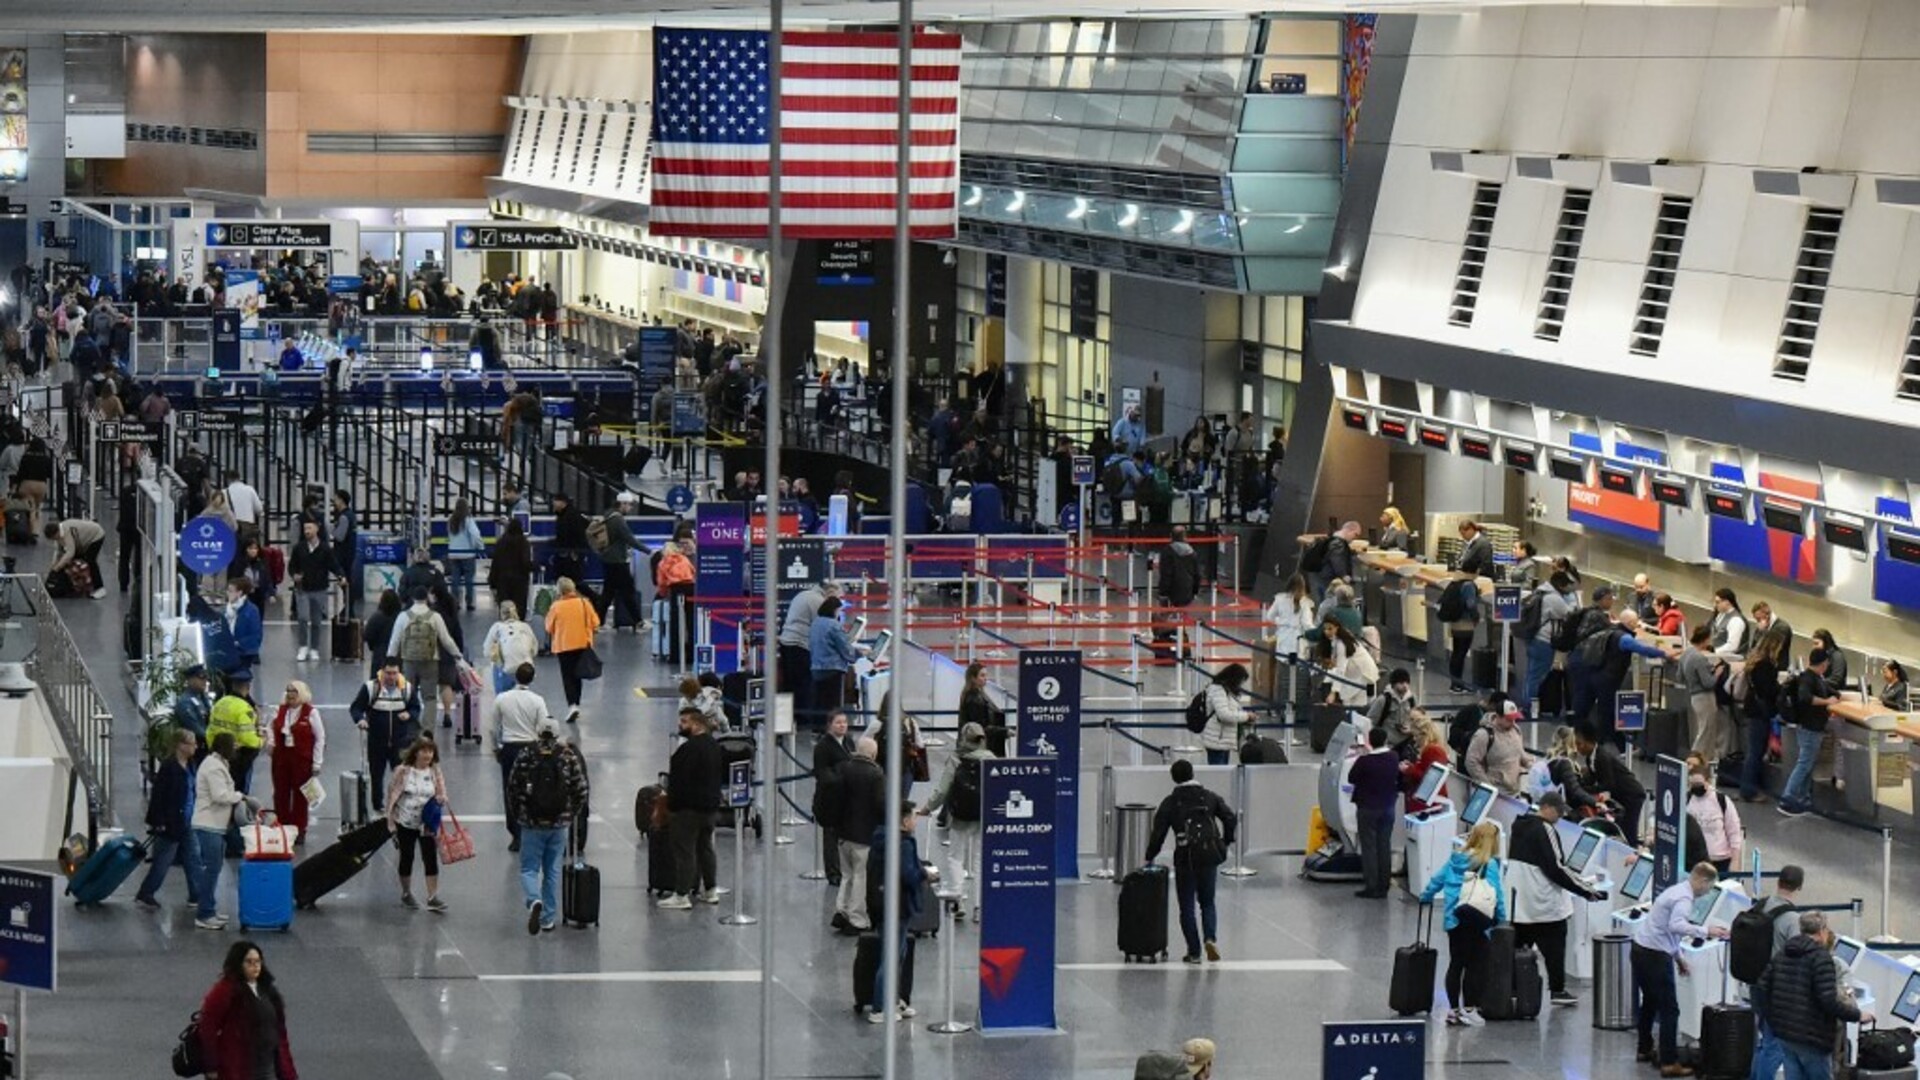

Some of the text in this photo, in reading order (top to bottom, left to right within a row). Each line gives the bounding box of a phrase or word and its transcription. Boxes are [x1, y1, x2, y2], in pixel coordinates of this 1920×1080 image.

[252, 226, 300, 235] Clear Plus
[252, 236, 321, 245] with PreCheck
[501, 233, 563, 243] TSA PreChe
[182, 246, 193, 270] TSA
[830, 253, 857, 261] Security
[200, 413, 226, 421] Security
[121, 424, 145, 432] Priority
[711, 528, 739, 539] ONE
[1034, 657, 1067, 665] DELTA
[1044, 682, 1053, 695] 2
[1001, 766, 1039, 775] DELTA
[986, 824, 1052, 834] APP BAG DROP
[0, 929, 14, 939] ACK
[1350, 1033, 1401, 1044] DELTA
